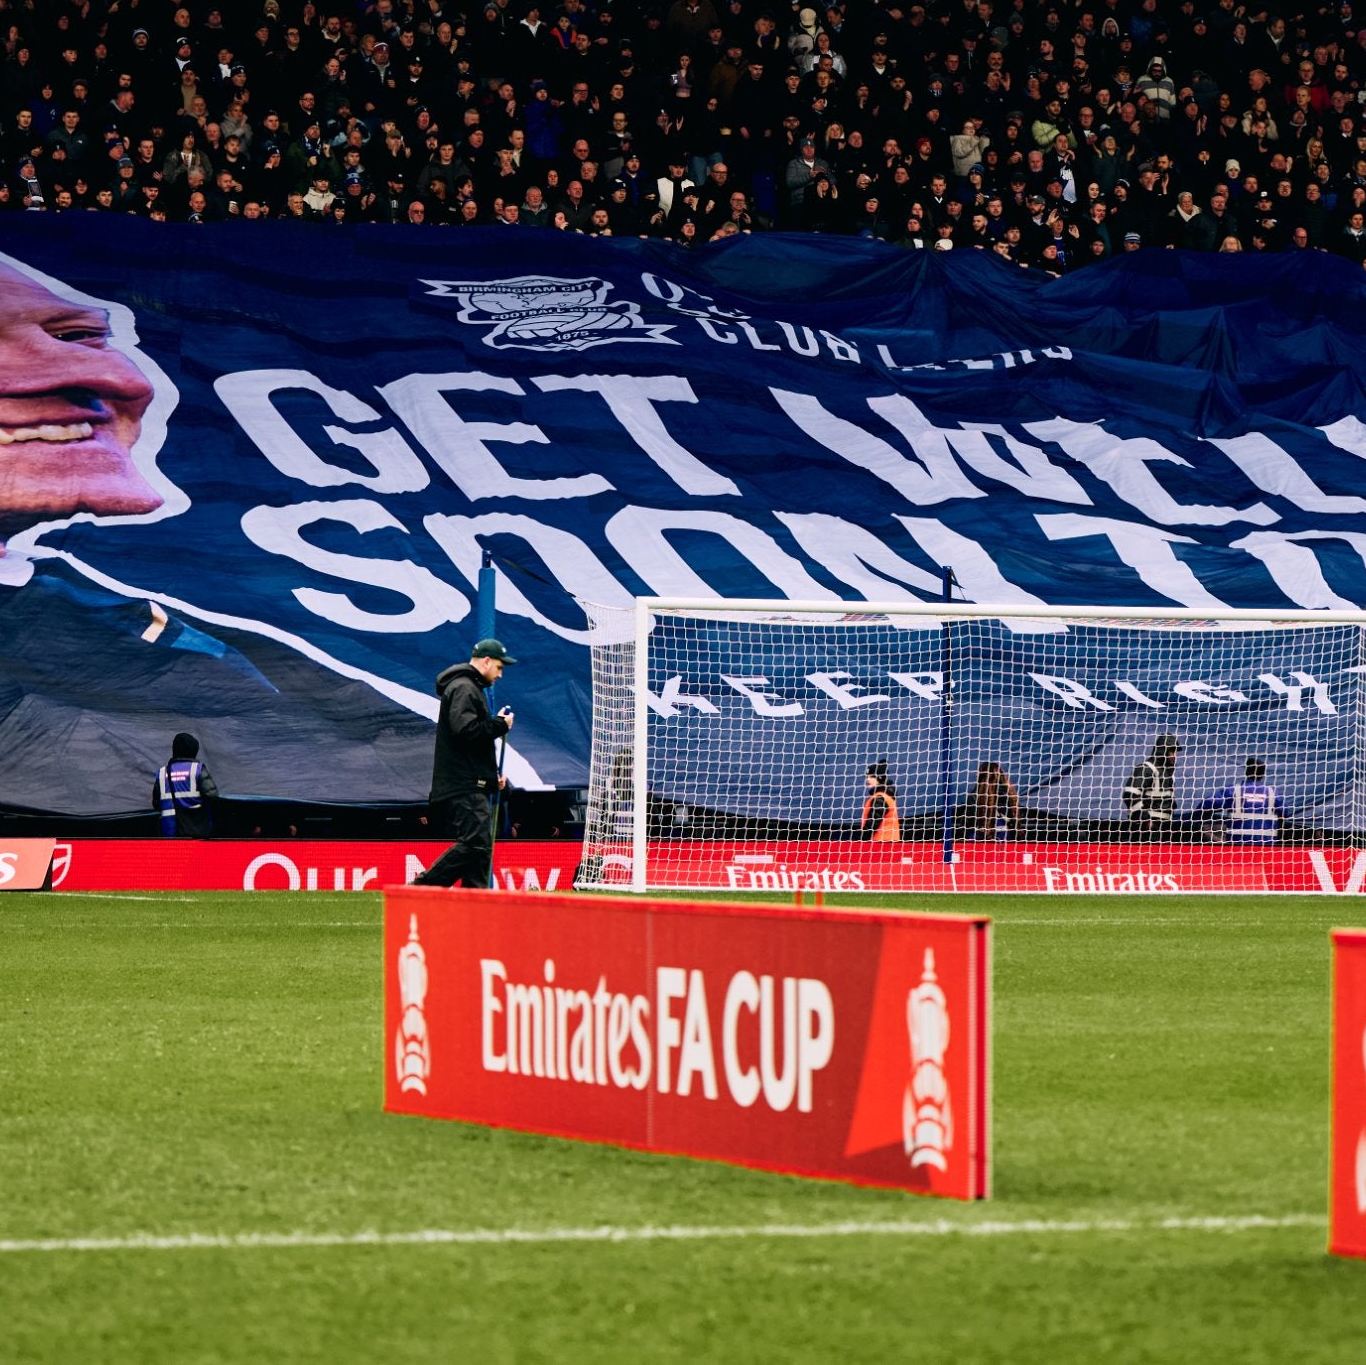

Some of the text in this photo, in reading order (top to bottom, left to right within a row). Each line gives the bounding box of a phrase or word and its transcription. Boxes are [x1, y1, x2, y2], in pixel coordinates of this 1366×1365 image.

[458, 280, 595, 294] BIRMINGHAM CITY
[490, 307, 565, 320] FOOTBALL
[555, 330, 589, 342] 1875
[215, 368, 743, 501] GET
[239, 499, 1070, 647] SOON
[628, 670, 955, 720] KEEP
[243, 852, 379, 892] Our
[726, 866, 866, 892] Emirates
[1043, 867, 1180, 893] Emirates
[480, 958, 835, 1114] Emirates FA CUP
